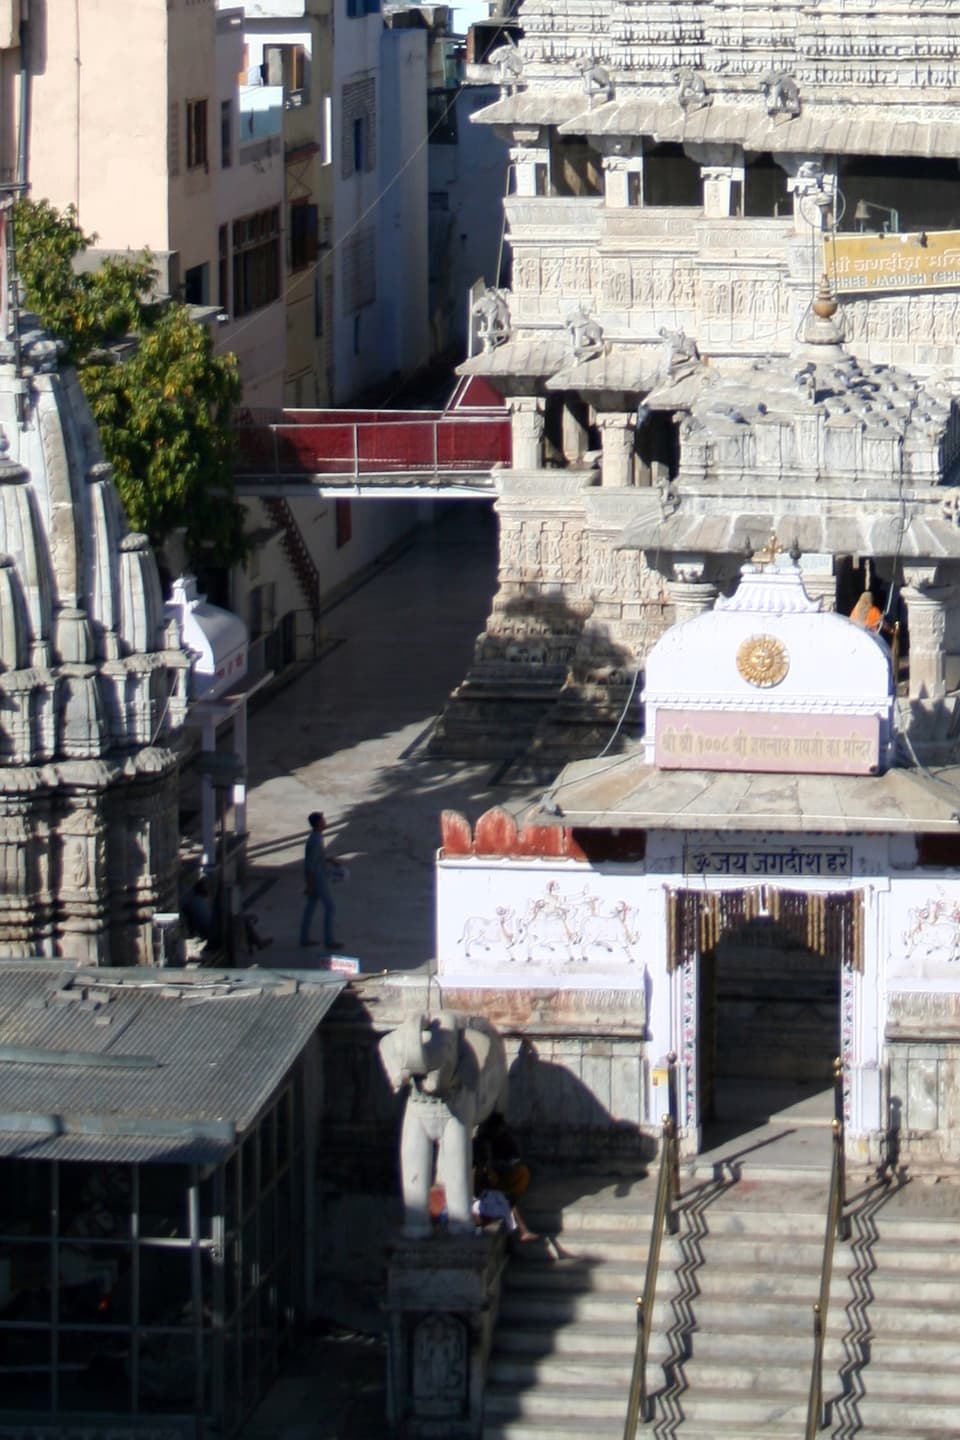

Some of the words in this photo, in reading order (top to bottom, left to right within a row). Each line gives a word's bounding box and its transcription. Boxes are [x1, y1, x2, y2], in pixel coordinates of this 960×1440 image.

[829, 275, 869, 290] SHREE
[871, 272, 928, 289] JAGDISH
[711, 852, 749, 873] जय
[751, 848, 822, 875] जगदीश
